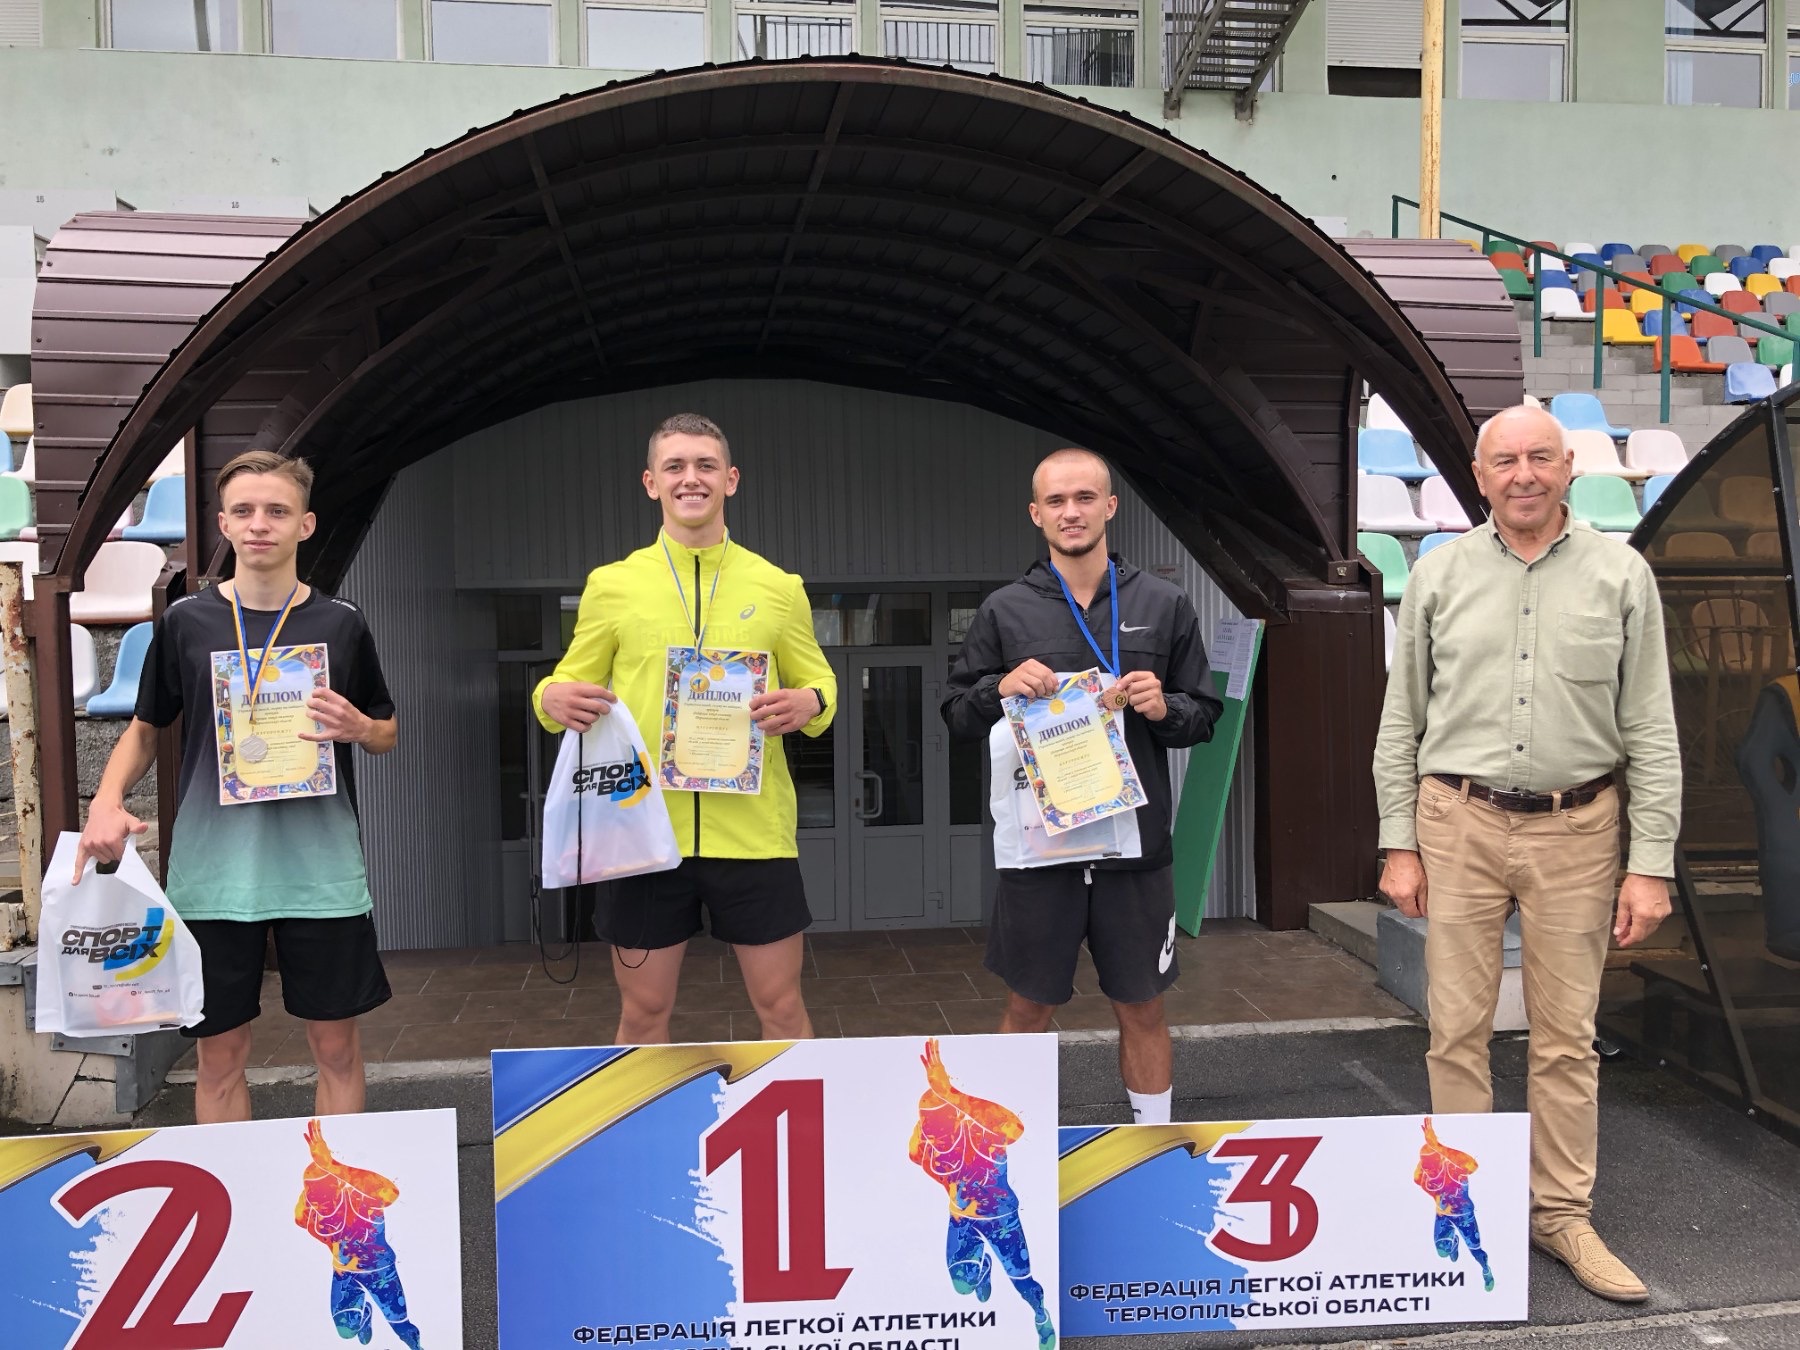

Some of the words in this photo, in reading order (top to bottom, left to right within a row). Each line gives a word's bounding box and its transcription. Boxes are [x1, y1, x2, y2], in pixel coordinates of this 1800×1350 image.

[1038, 715, 1091, 744] ДИПЛОМ
[572, 760, 646, 785] СПОРТ
[597, 774, 652, 796] ВСІХ
[61, 925, 162, 948] СПОРТ
[61, 946, 90, 956] ДЛЯ
[88, 942, 162, 964] ВСІХ
[706, 1078, 855, 1304] 1
[1211, 1135, 1324, 1263] 3
[57, 1160, 254, 1350] 2
[1069, 1279, 1221, 1303] ФЕДЕРАЦІЯ
[1228, 1271, 1323, 1295] ЛЕГКОЇ
[1328, 1271, 1465, 1291] АТЛЕТИКИ
[1104, 1296, 1319, 1323] ТЕРНОПІЛЬСЬКОЇ
[1325, 1296, 1431, 1315] ОБЛАСТІ
[573, 1320, 737, 1346] ФЕДЕРАЦІЯ
[744, 1312, 845, 1337] ЛЕГКОЇ
[851, 1310, 997, 1333] АТЛЕТИКИ
